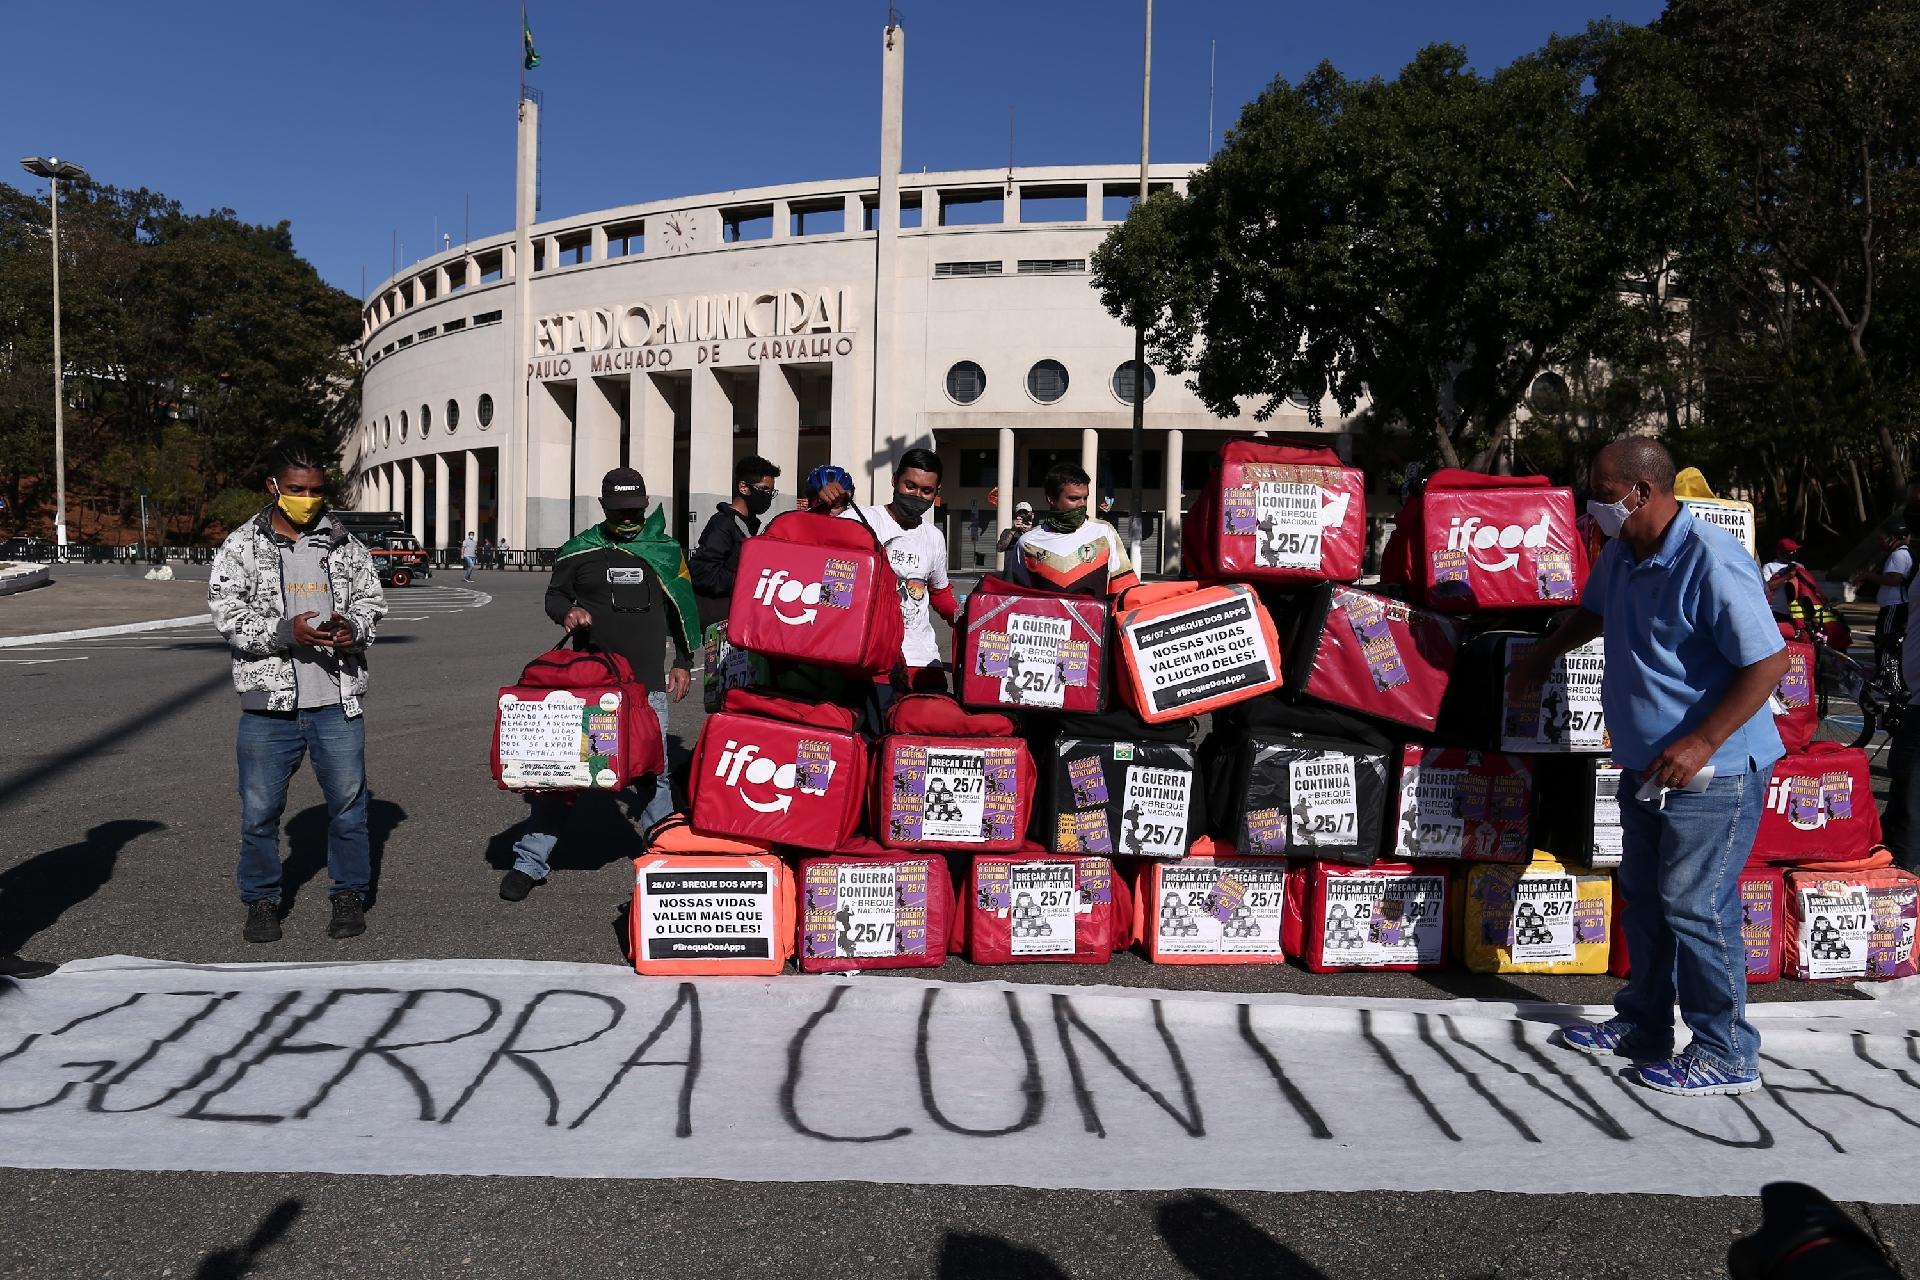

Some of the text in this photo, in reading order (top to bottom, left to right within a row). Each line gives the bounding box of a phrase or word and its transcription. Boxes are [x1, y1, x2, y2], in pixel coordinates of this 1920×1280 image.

[666, 285, 856, 344] MUNICIPAL
[528, 337, 852, 379] PAULO MACHADO DE CARVALHO
[1263, 483, 1317, 495] A GUERRA
[1263, 497, 1316, 509] CONTINUA
[1236, 509, 1255, 517] 25/7
[1705, 513, 1745, 525] GUERRA
[1448, 515, 1550, 551] ifood
[1278, 533, 1318, 554] 25/7
[753, 569, 822, 605] ifoo
[1012, 620, 1065, 635] A GUERRA
[1141, 607, 1246, 643] 25/07 BREQUE DOS APPS
[1153, 627, 1245, 660] NOSSAS VIDAS
[1150, 637, 1254, 673] VALEM MAIS QUE
[1156, 650, 1257, 685] O LUCRO DELES!
[1560, 659, 1604, 670] GUERRA
[1550, 673, 1602, 684] CONTINUA
[1177, 673, 1246, 697] #BrequeDosApps
[1561, 712, 1603, 731] 25/7
[600, 733, 616, 741] 25/7
[931, 758, 975, 768] BRECAR ATÉ
[810, 764, 828, 774] 25/7
[1295, 763, 1349, 777] A GUERRA
[1086, 777, 1104, 789] 25/7
[1132, 772, 1185, 787] A GUERRA
[1295, 777, 1349, 790] CONTINUA
[953, 778, 982, 793] 25/7
[1130, 786, 1184, 801] CONTINUA
[1315, 790, 1351, 798] BREQUE
[1149, 801, 1184, 810] BREQUE
[1148, 809, 1184, 817] NACIONAL
[1314, 813, 1355, 833] 25/7
[1142, 824, 1183, 845] 25/7
[1420, 824, 1461, 844] 25/7
[840, 873, 894, 884] A GUERRA
[1016, 872, 1046, 881] BRECAR
[1049, 870, 1062, 880] ATÉ
[1166, 872, 1210, 881] BRECAR ATÉ
[1259, 872, 1272, 882] ATÉ
[652, 881, 675, 889] 25/07
[682, 881, 717, 889] BREQUE
[740, 880, 763, 888] APPS
[907, 884, 925, 892] 25/7
[991, 884, 1009, 893] 25/7
[1093, 880, 1111, 889] 25/7
[1163, 882, 1182, 890] TAXA
[1332, 883, 1376, 893] BRECAR ATÉ
[1518, 883, 1547, 892] BRECAR
[1550, 882, 1562, 892] ATÉ
[818, 887, 836, 895] 25/7
[840, 887, 894, 897] CONTINUA
[660, 899, 756, 908] NOSSAS VIDAS
[1041, 891, 1071, 906] 25/7
[1251, 893, 1281, 907] 25/7
[1410, 902, 1439, 916] 25/7
[1544, 901, 1572, 916] 25/7
[1754, 902, 1771, 911] 25/7
[653, 912, 763, 921] VALEM MAIS QUE
[1837, 915, 1866, 929] 25/7
[1585, 919, 1603, 927] 25/7
[656, 924, 761, 934] O LUCRO DELES!
[854, 923, 895, 942] 25/7
[907, 929, 924, 938] 25/7
[817, 934, 835, 942] 25/7
[673, 943, 745, 952] #BrequeDosApps
[1879, 952, 1895, 960] 25/7
